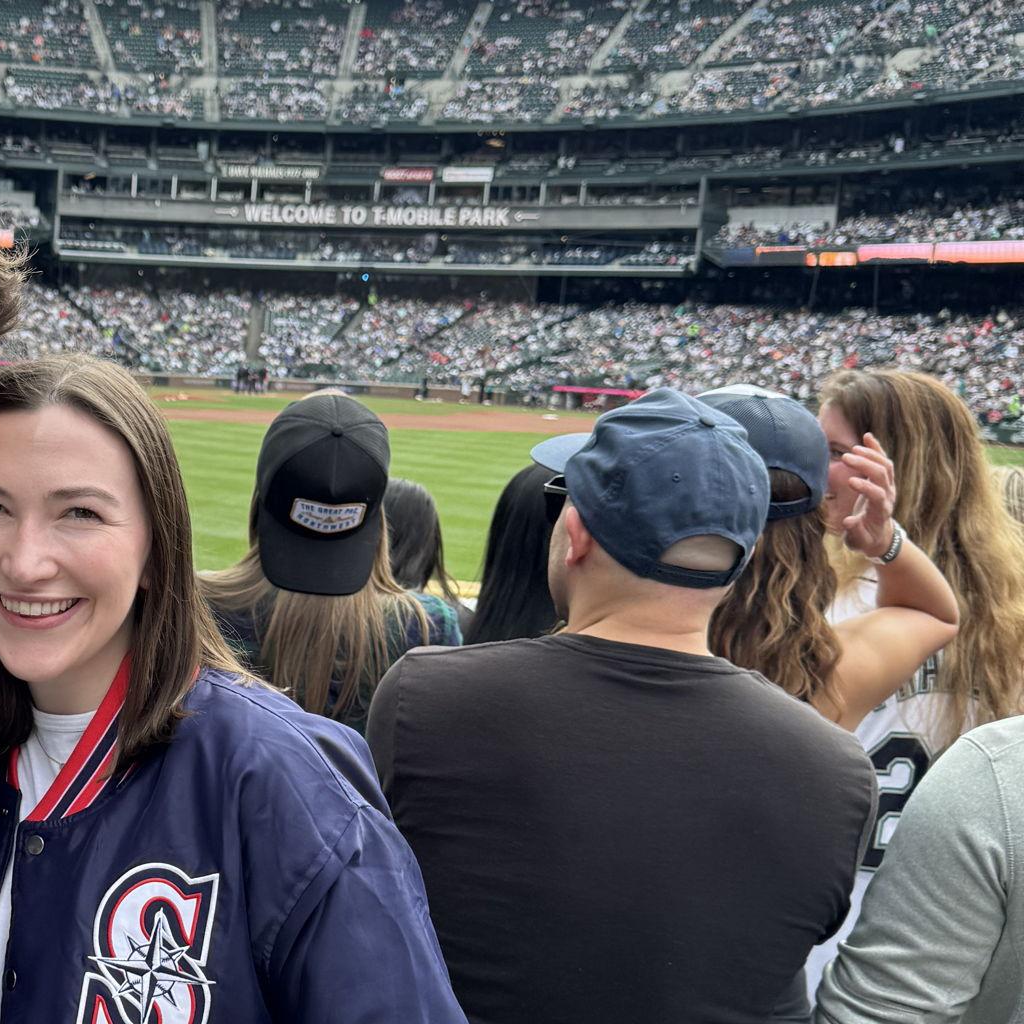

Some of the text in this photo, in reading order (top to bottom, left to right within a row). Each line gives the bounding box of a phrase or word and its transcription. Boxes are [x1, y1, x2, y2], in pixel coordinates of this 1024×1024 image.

[244, 203, 510, 226] WELCOME TO T-MOBILE PARK
[301, 503, 315, 513] THE
[318, 507, 342, 515] GREAT
